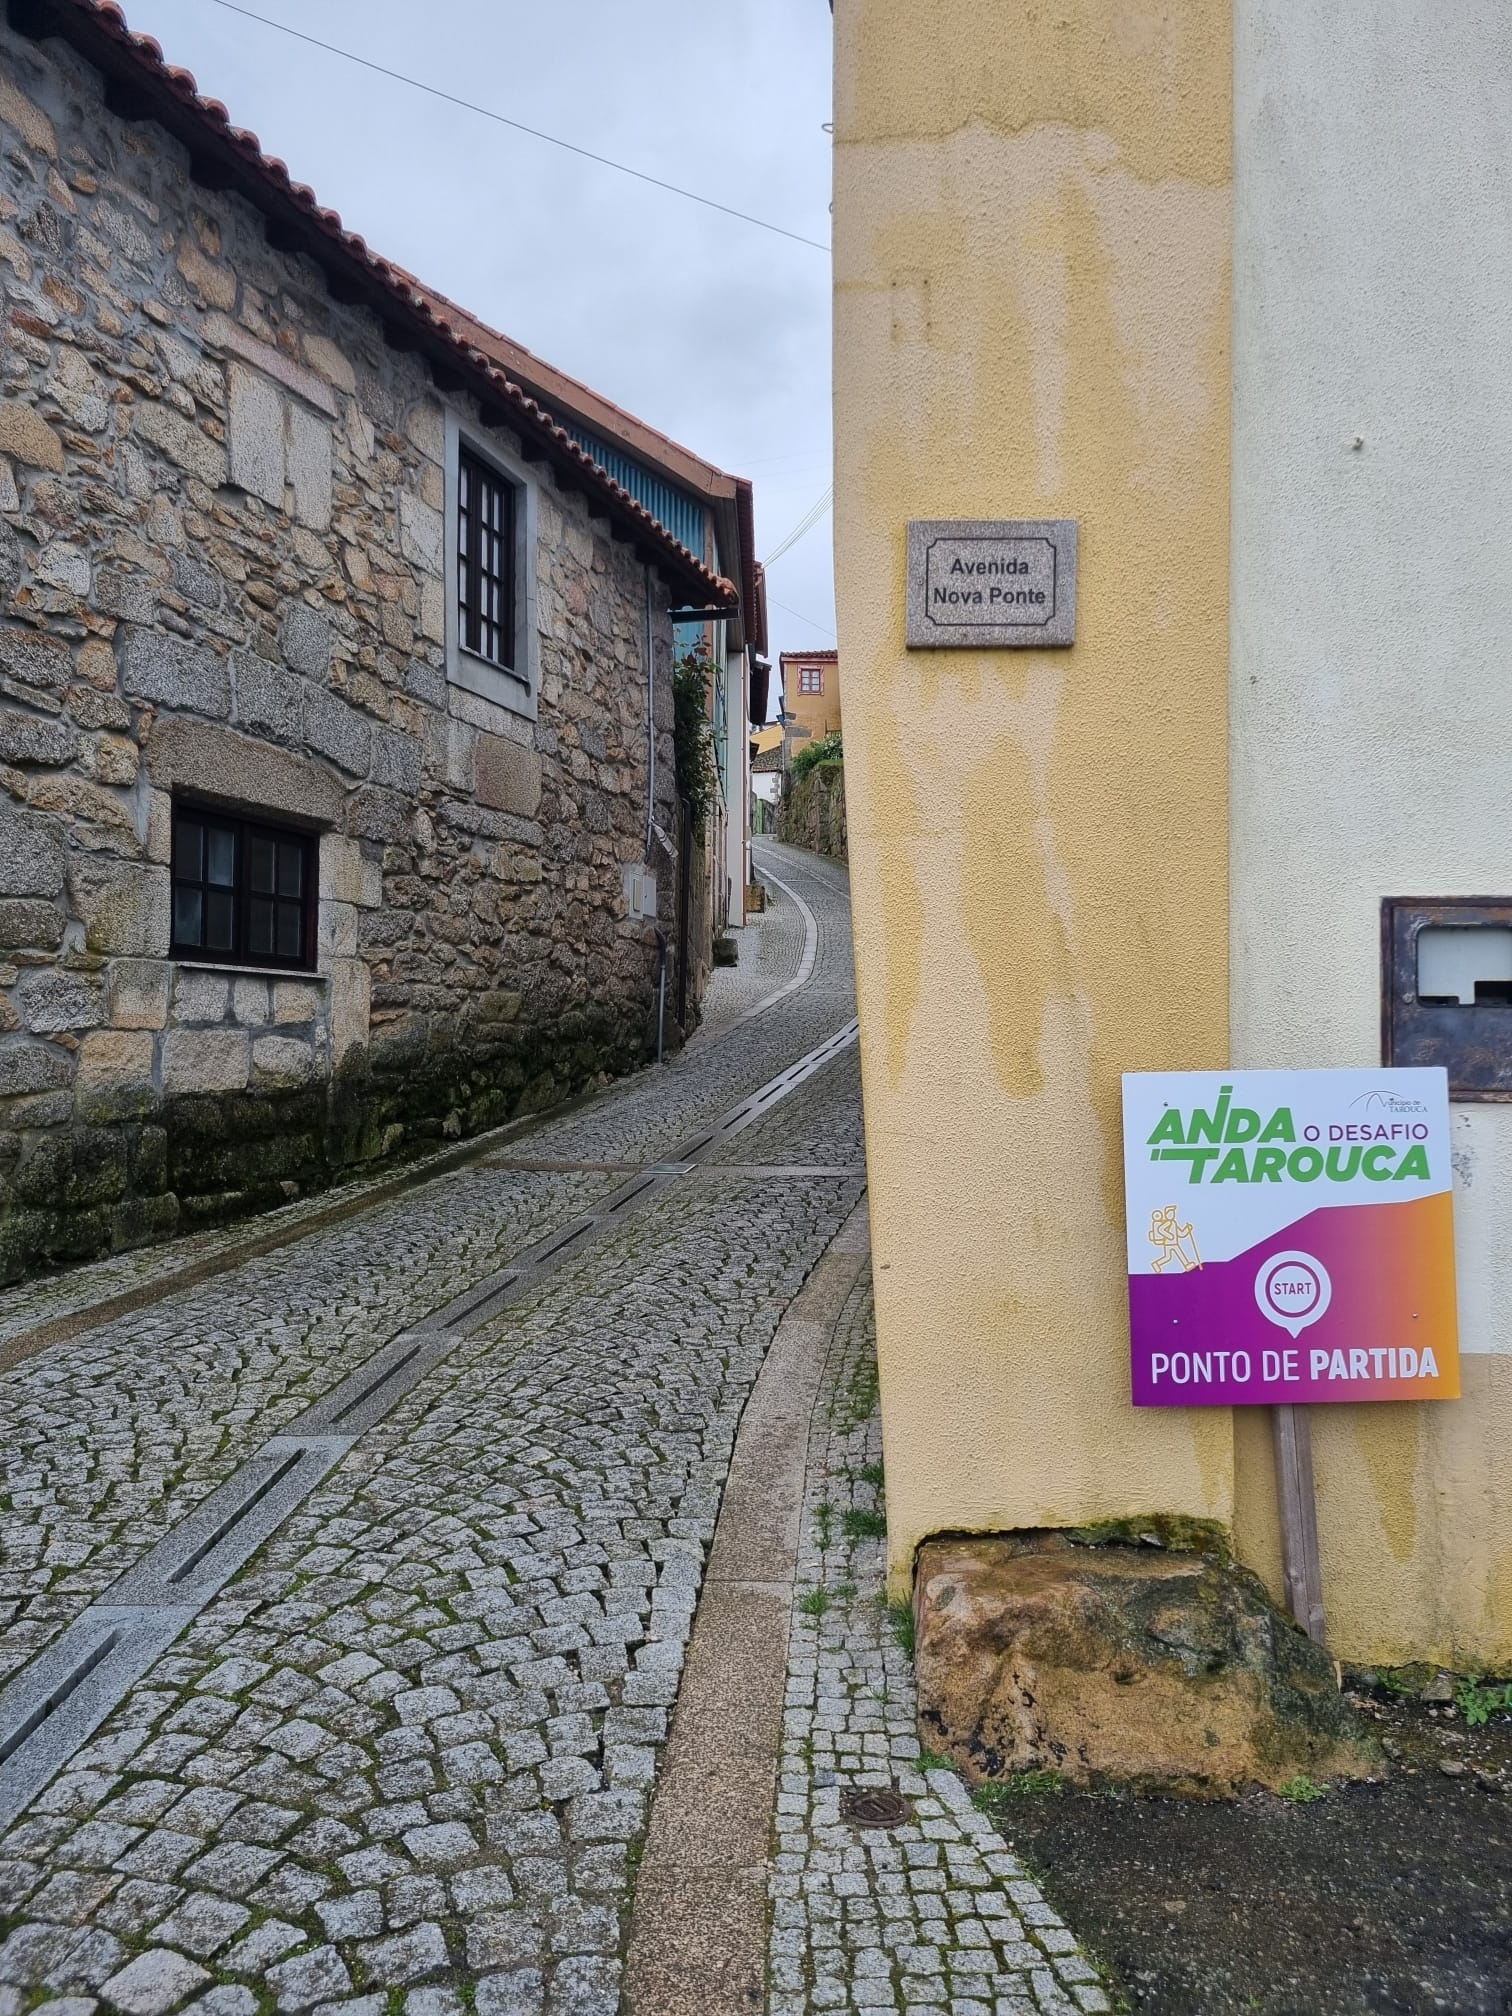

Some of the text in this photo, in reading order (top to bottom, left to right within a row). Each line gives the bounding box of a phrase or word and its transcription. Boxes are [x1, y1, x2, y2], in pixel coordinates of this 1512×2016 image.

[950, 558, 1029, 575] Avenida
[933, 587, 1046, 604] Nova Ponte
[1146, 1085, 1297, 1145] ANDA
[1303, 1123, 1429, 1142] O DESAFIO
[1150, 1144, 1431, 1184] TAROUCA
[1274, 1282, 1312, 1295] START
[1151, 1347, 1440, 1384] PONTO DE PARTIDA
